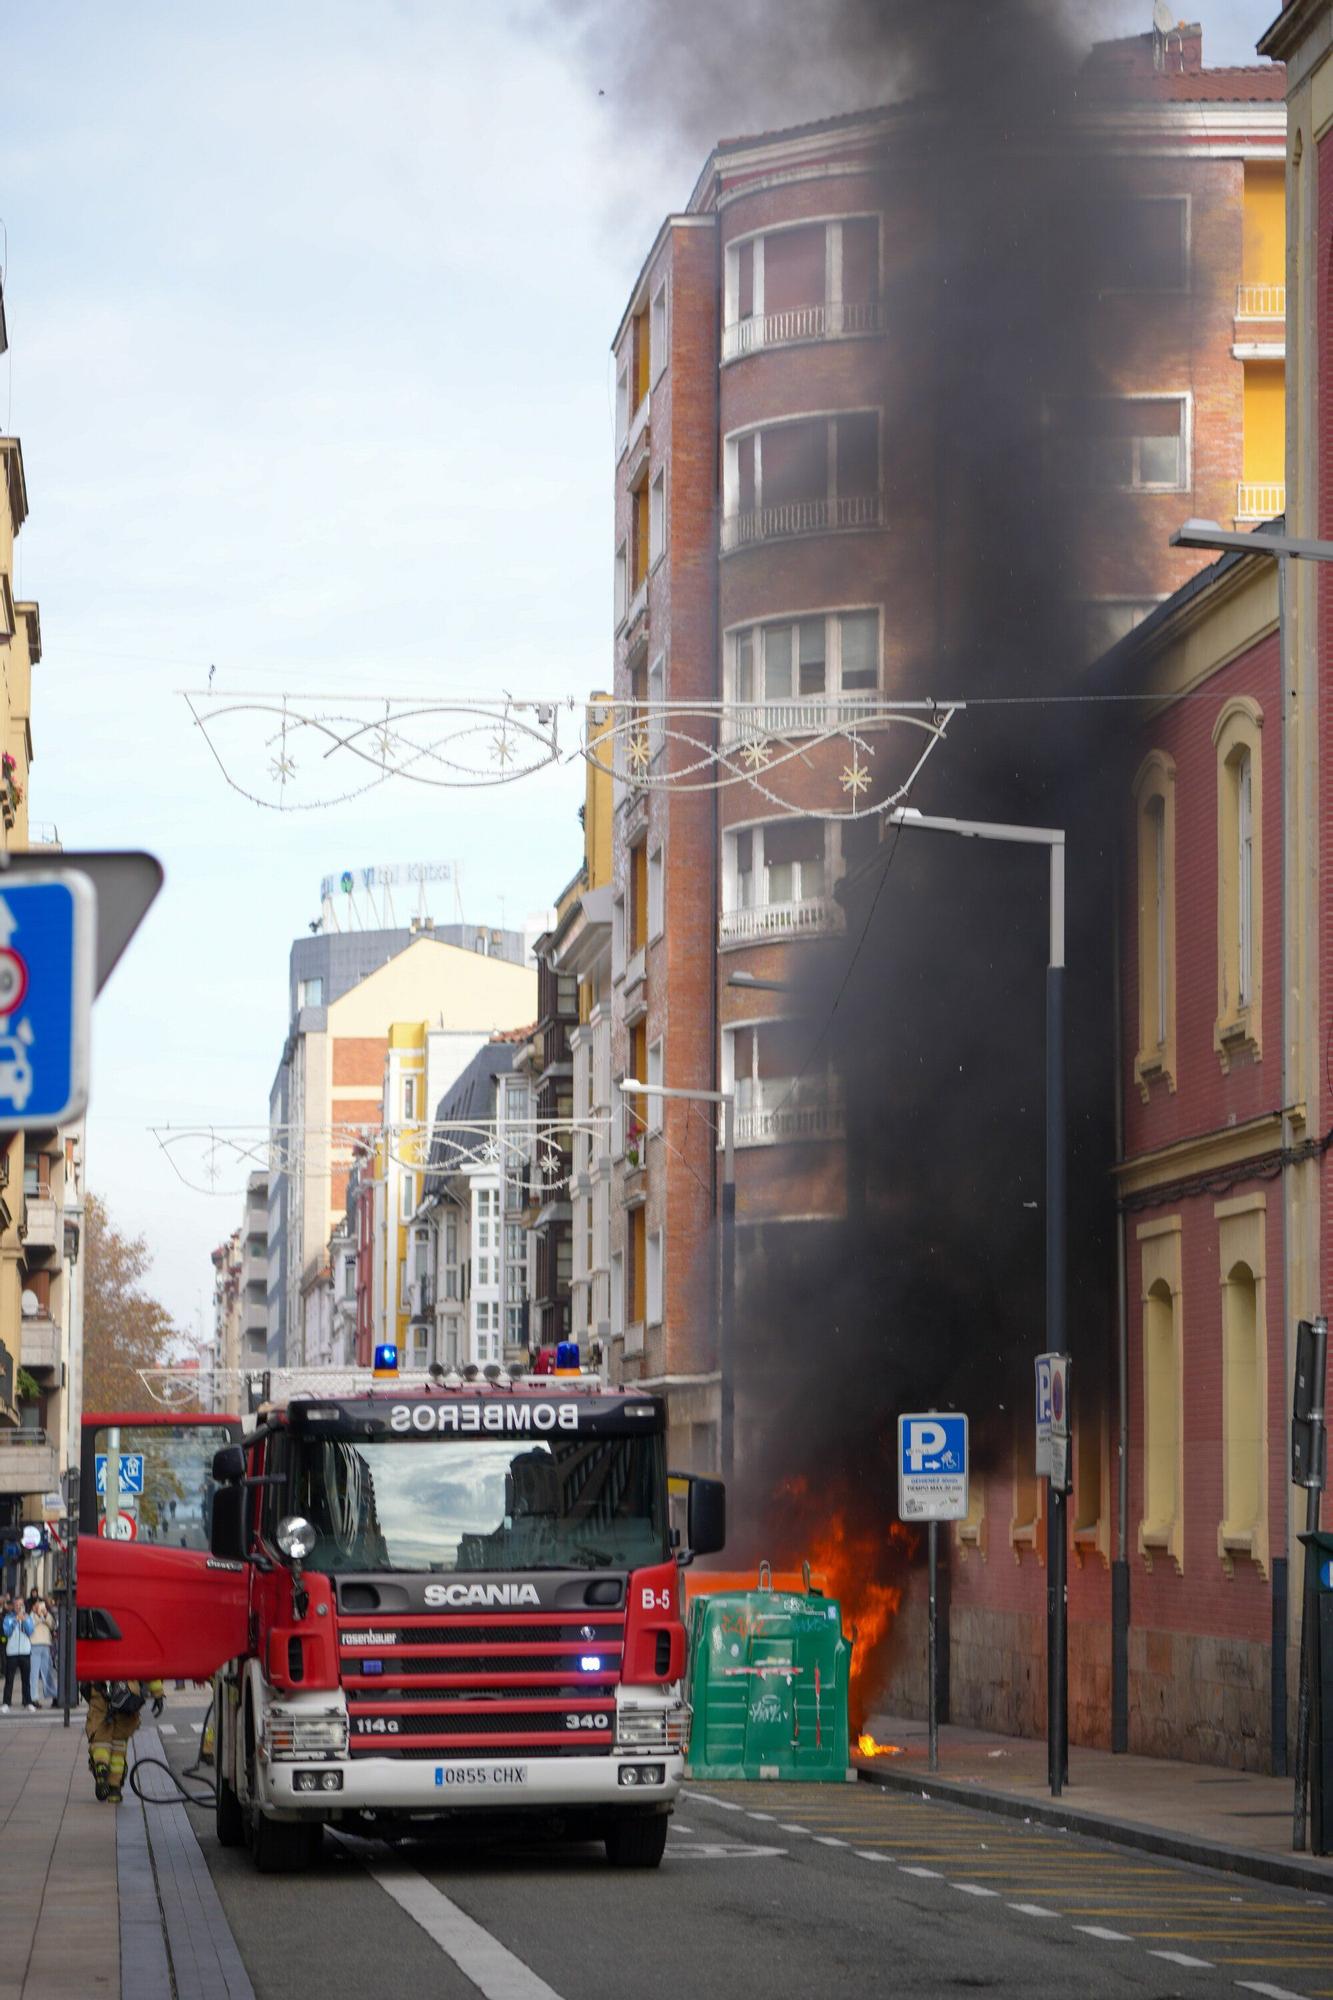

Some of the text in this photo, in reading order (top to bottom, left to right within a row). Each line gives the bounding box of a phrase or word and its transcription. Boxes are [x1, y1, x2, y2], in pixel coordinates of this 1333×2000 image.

[910, 1421, 947, 1471] P
[424, 1583, 541, 1607] SCANIA
[641, 1588, 670, 1610] B-5
[341, 1628, 397, 1645] rosenbauer
[565, 1714, 608, 1730] 340
[445, 1767, 524, 1784] 0855 CHX
